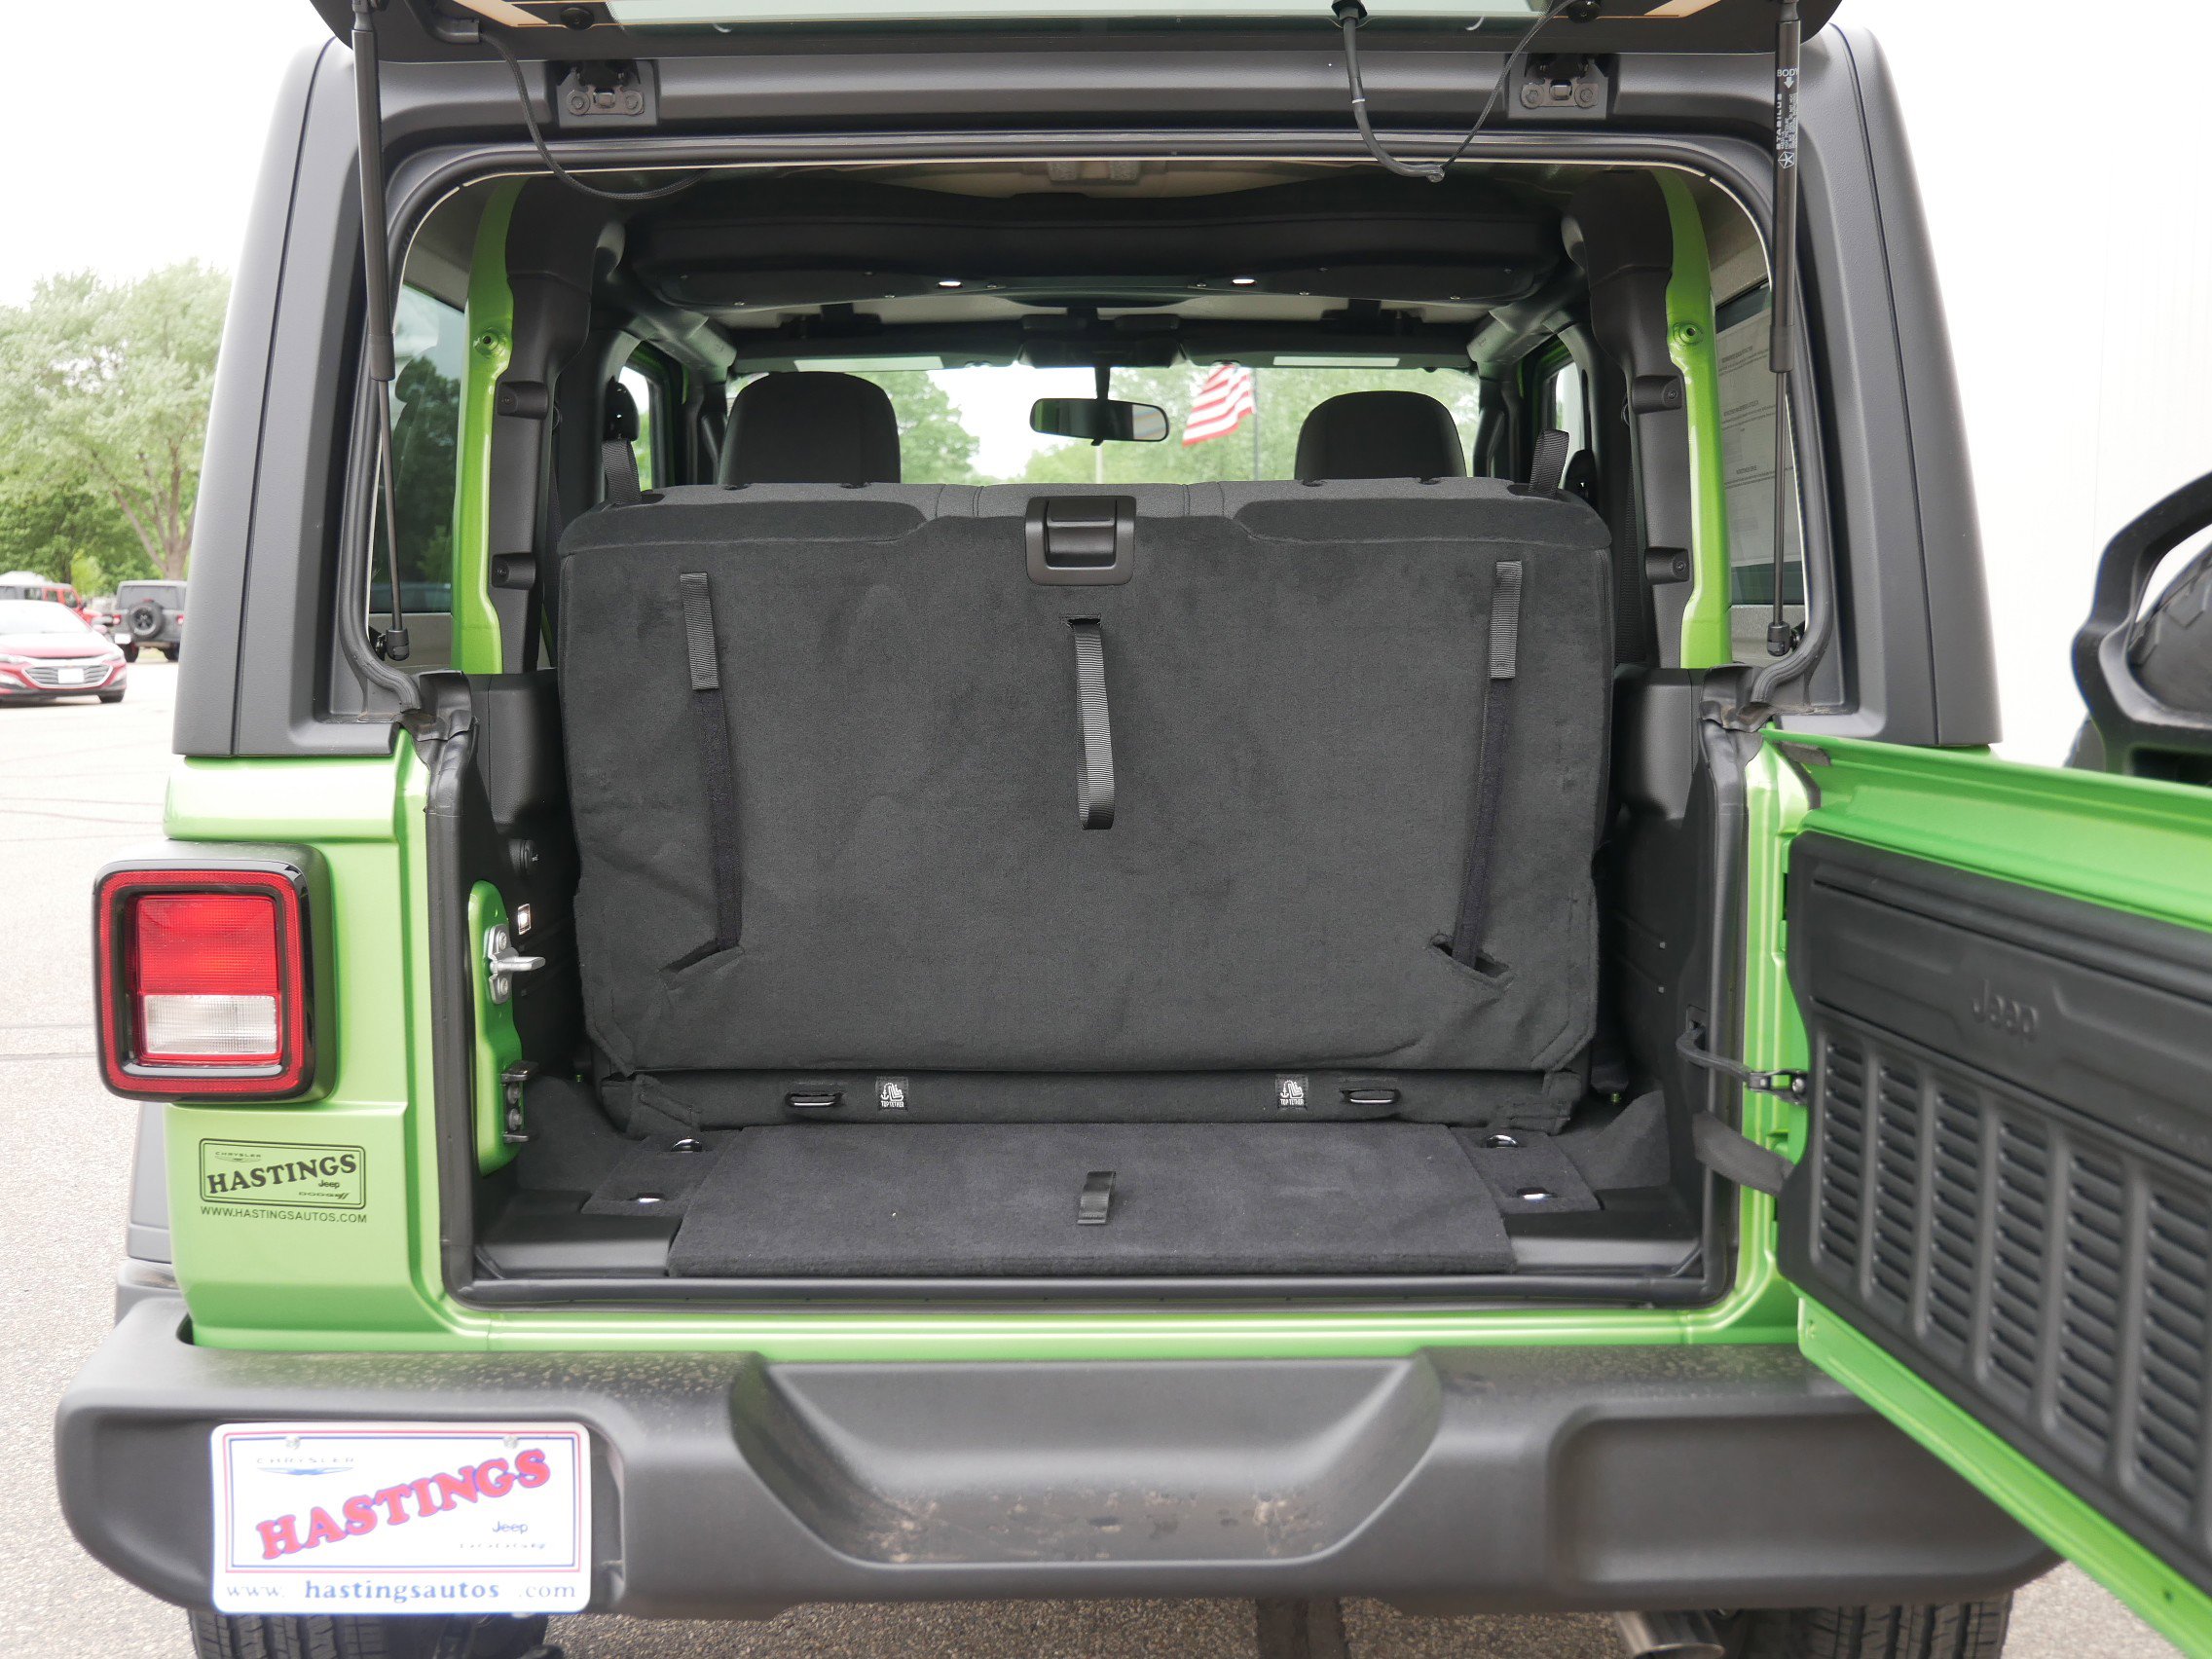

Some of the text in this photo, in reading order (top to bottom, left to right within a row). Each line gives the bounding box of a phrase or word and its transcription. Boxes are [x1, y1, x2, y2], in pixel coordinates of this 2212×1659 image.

[1777, 68, 1799, 77] BODY
[1972, 978, 2040, 1044] Jeep
[207, 1154, 356, 1194] HASTINGS
[318, 1179, 340, 1189] Jeep
[201, 1206, 367, 1223] WWW.HASTINGSAUTOS.COM
[256, 1448, 551, 1560] HASTINGS
[492, 1521, 529, 1534] Jeep
[305, 1581, 499, 1604] hastingsautos
